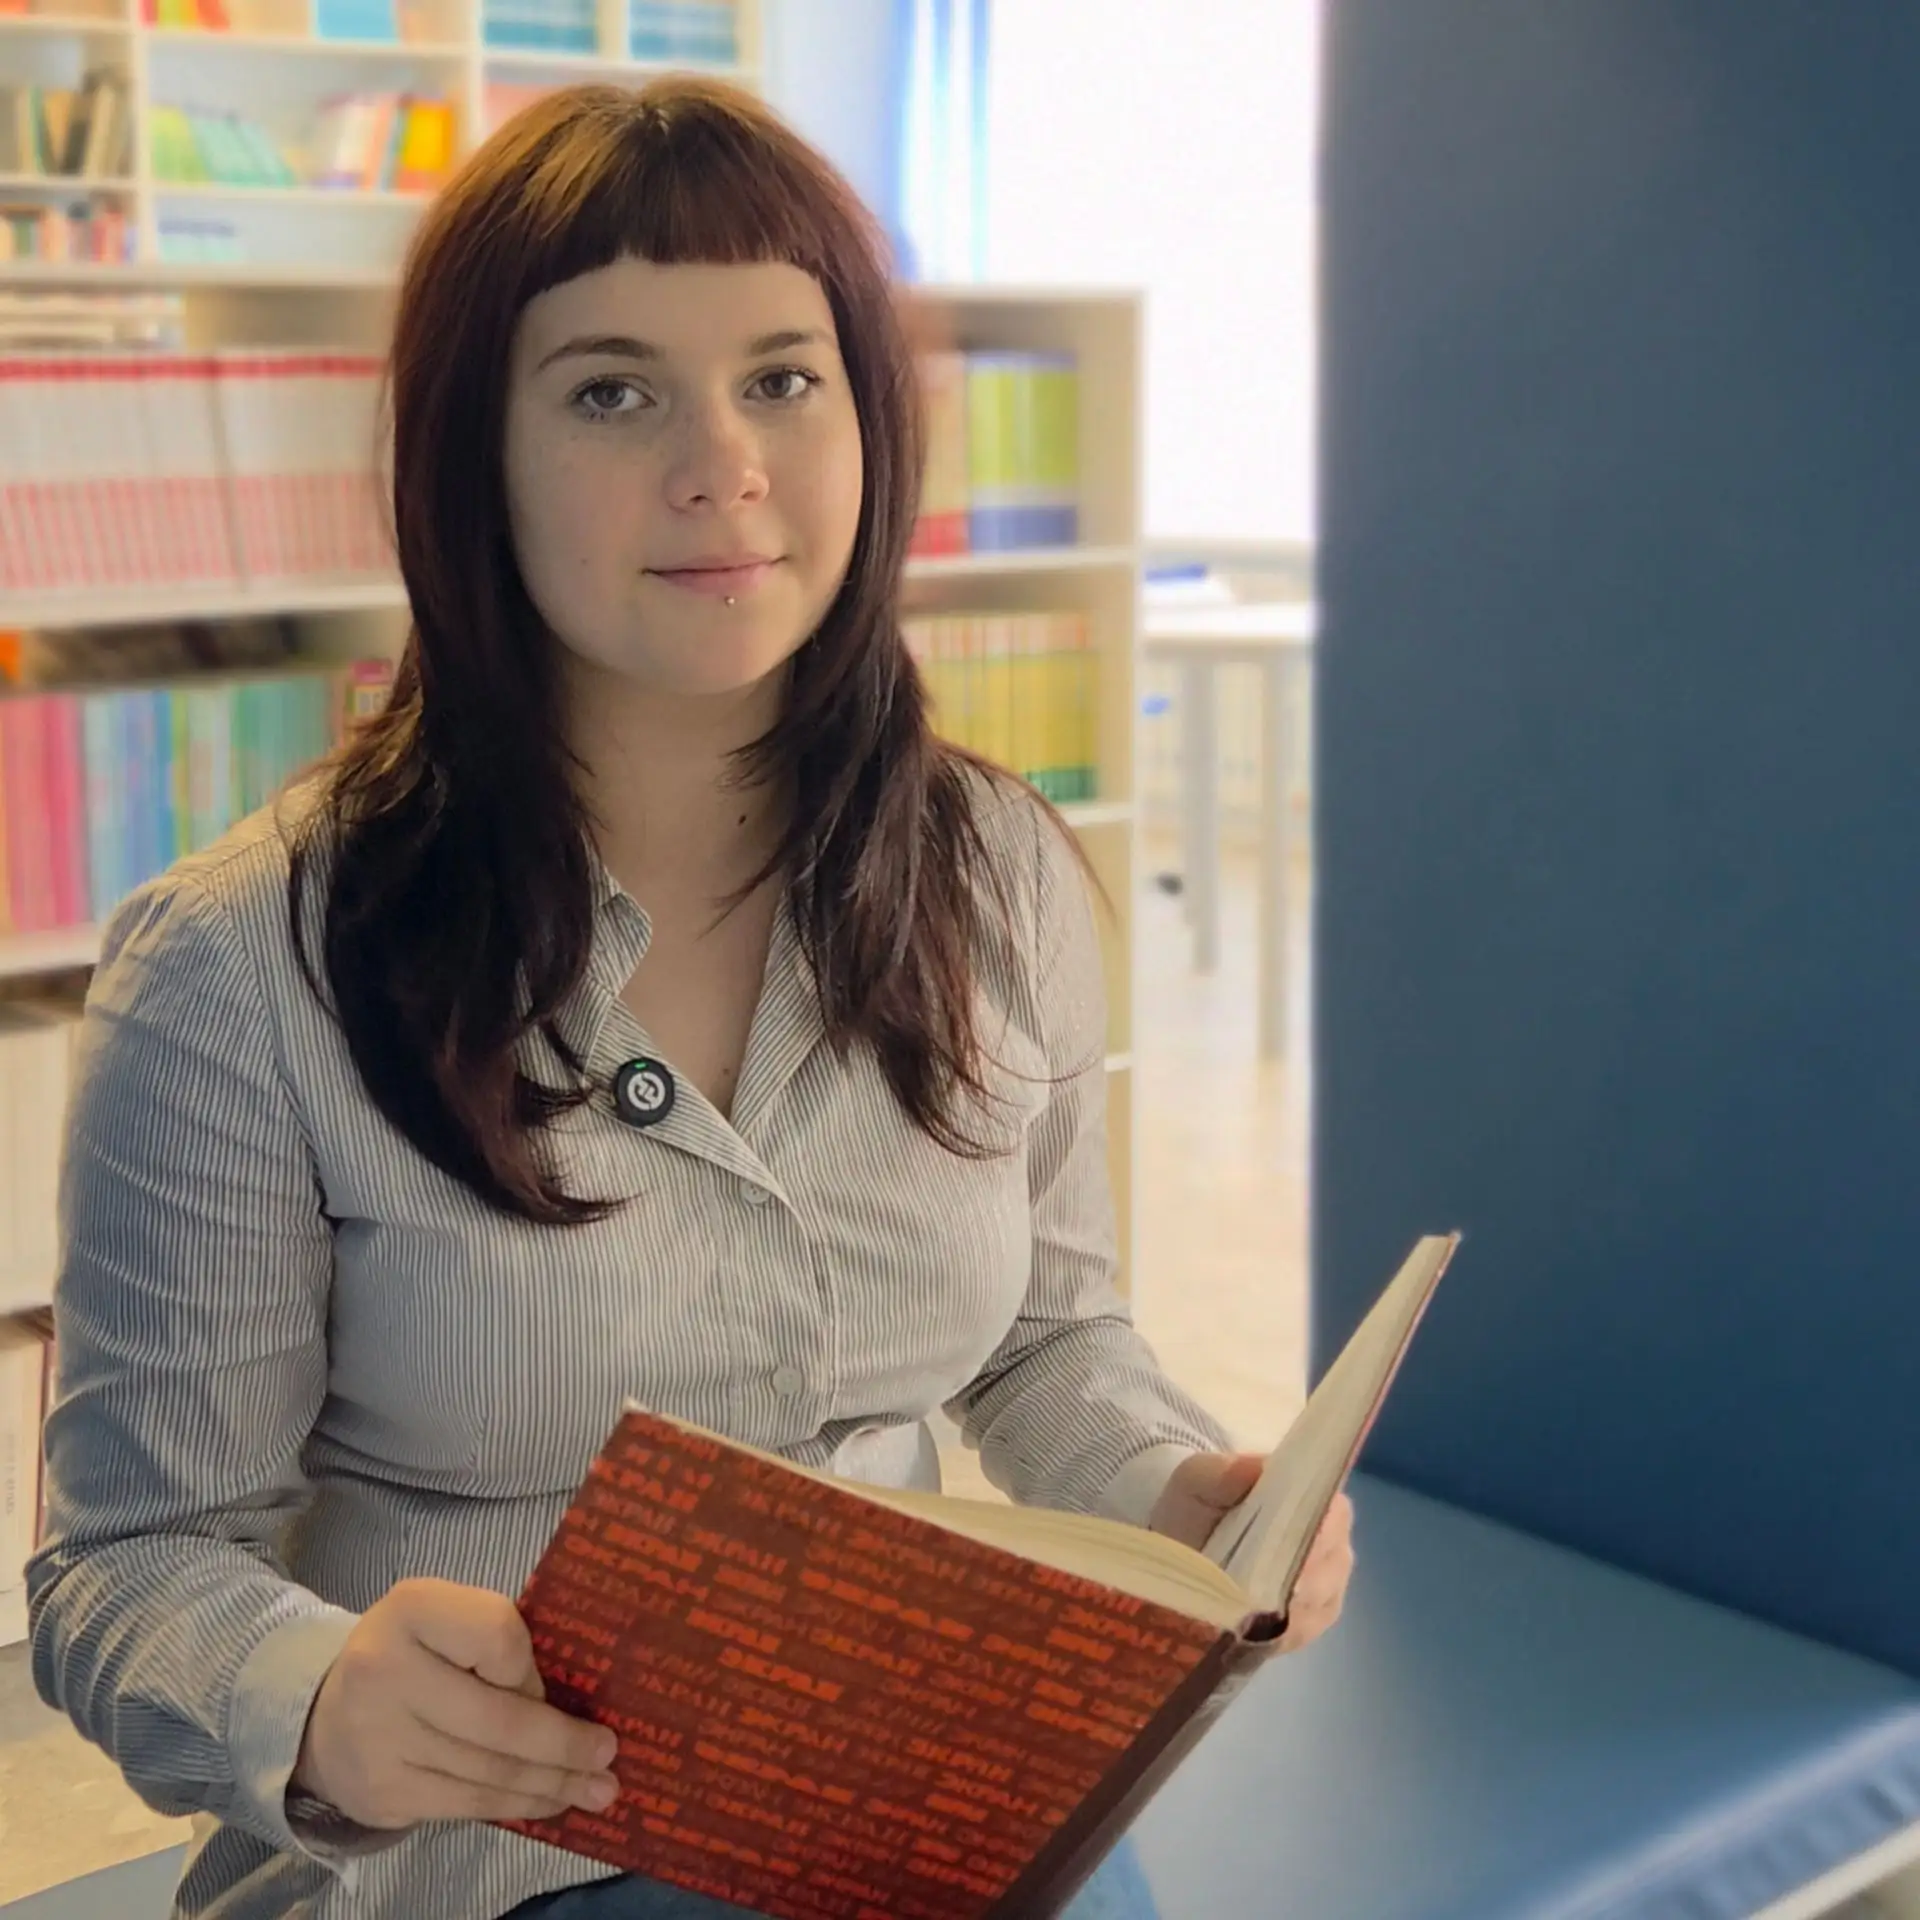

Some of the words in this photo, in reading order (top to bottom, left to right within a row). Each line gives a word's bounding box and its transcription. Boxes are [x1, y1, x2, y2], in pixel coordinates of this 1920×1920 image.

[1059, 1602, 1174, 1656] ЭКРАН
[717, 1644, 844, 1703] ЭКРАН
[906, 1734, 1013, 1786] ЭКРАН
